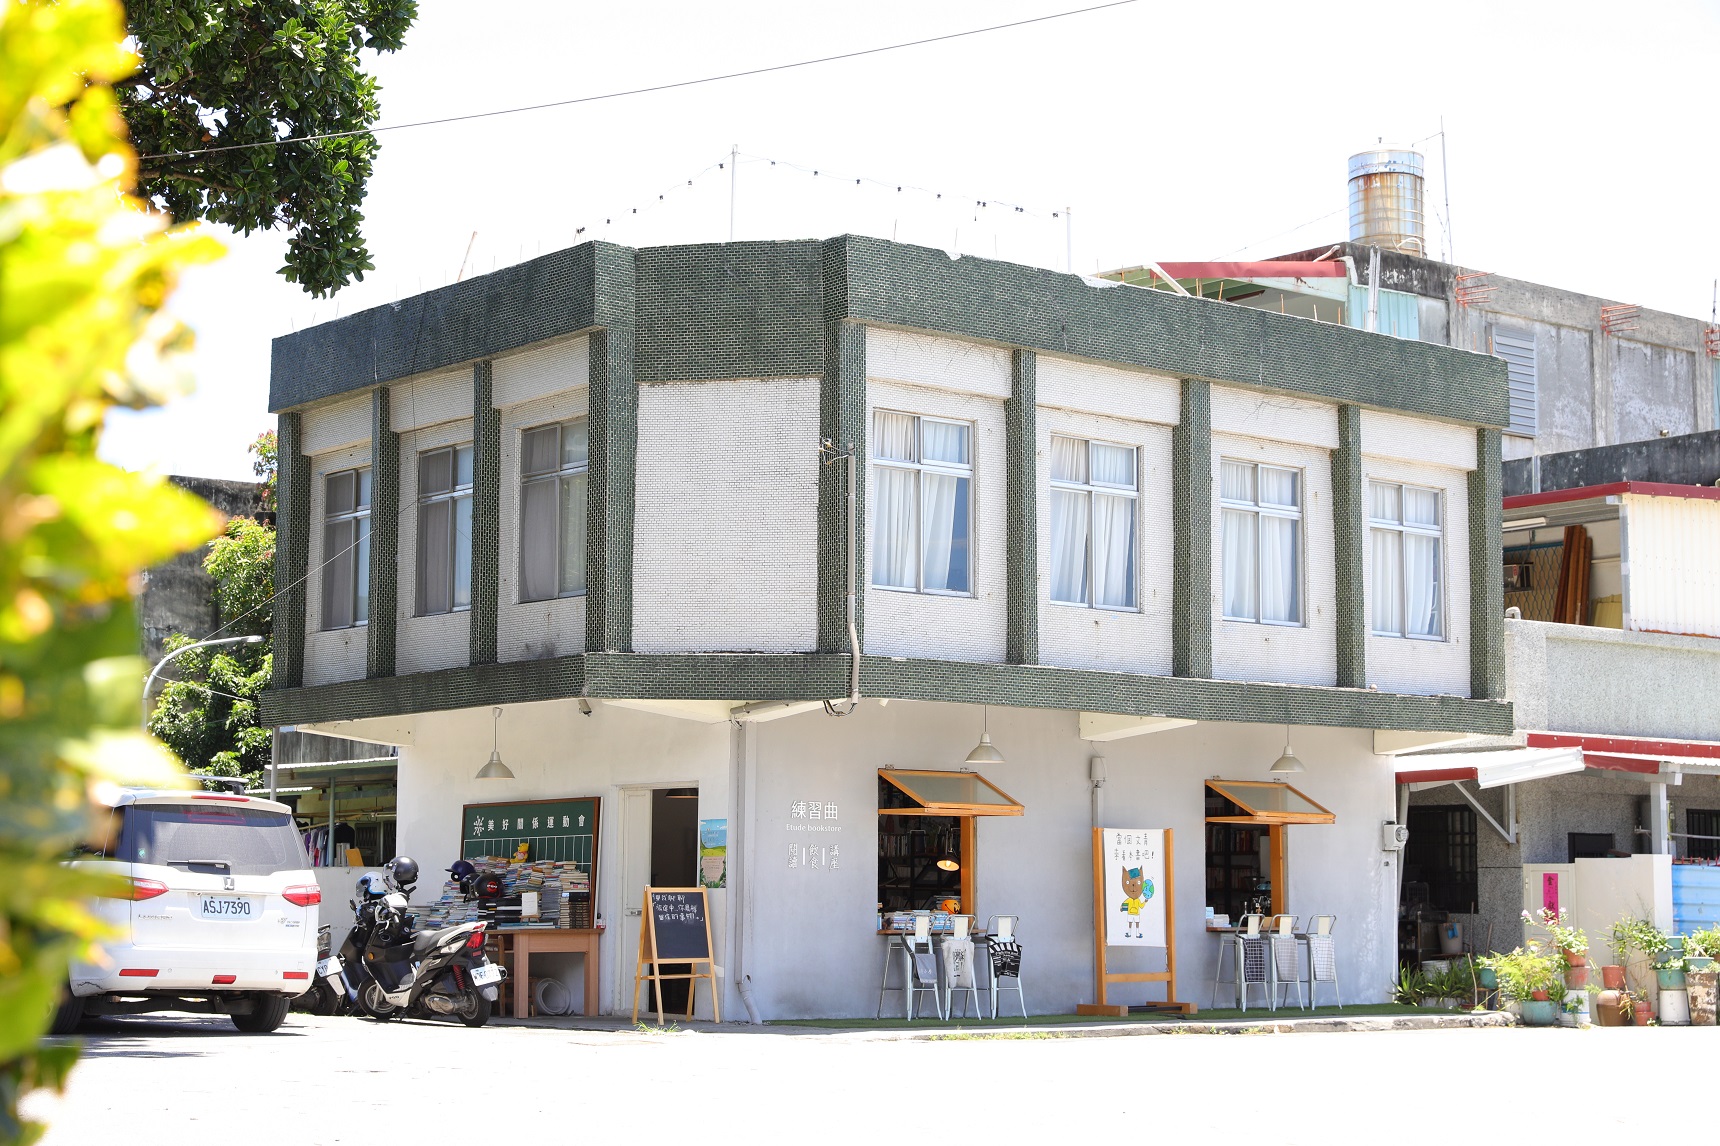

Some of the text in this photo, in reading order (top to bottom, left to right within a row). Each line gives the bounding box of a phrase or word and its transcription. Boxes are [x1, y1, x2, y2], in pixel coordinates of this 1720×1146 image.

[791, 800, 838, 820] 練習曲
[487, 814, 586, 832] 美好關係運動會
[786, 823, 842, 833] Etude bookstore
[1115, 832, 1148, 847] 當個文青
[808, 844, 820, 870] 飲食
[828, 844, 841, 870] 講座
[203, 900, 251, 916] ASJ-7390
